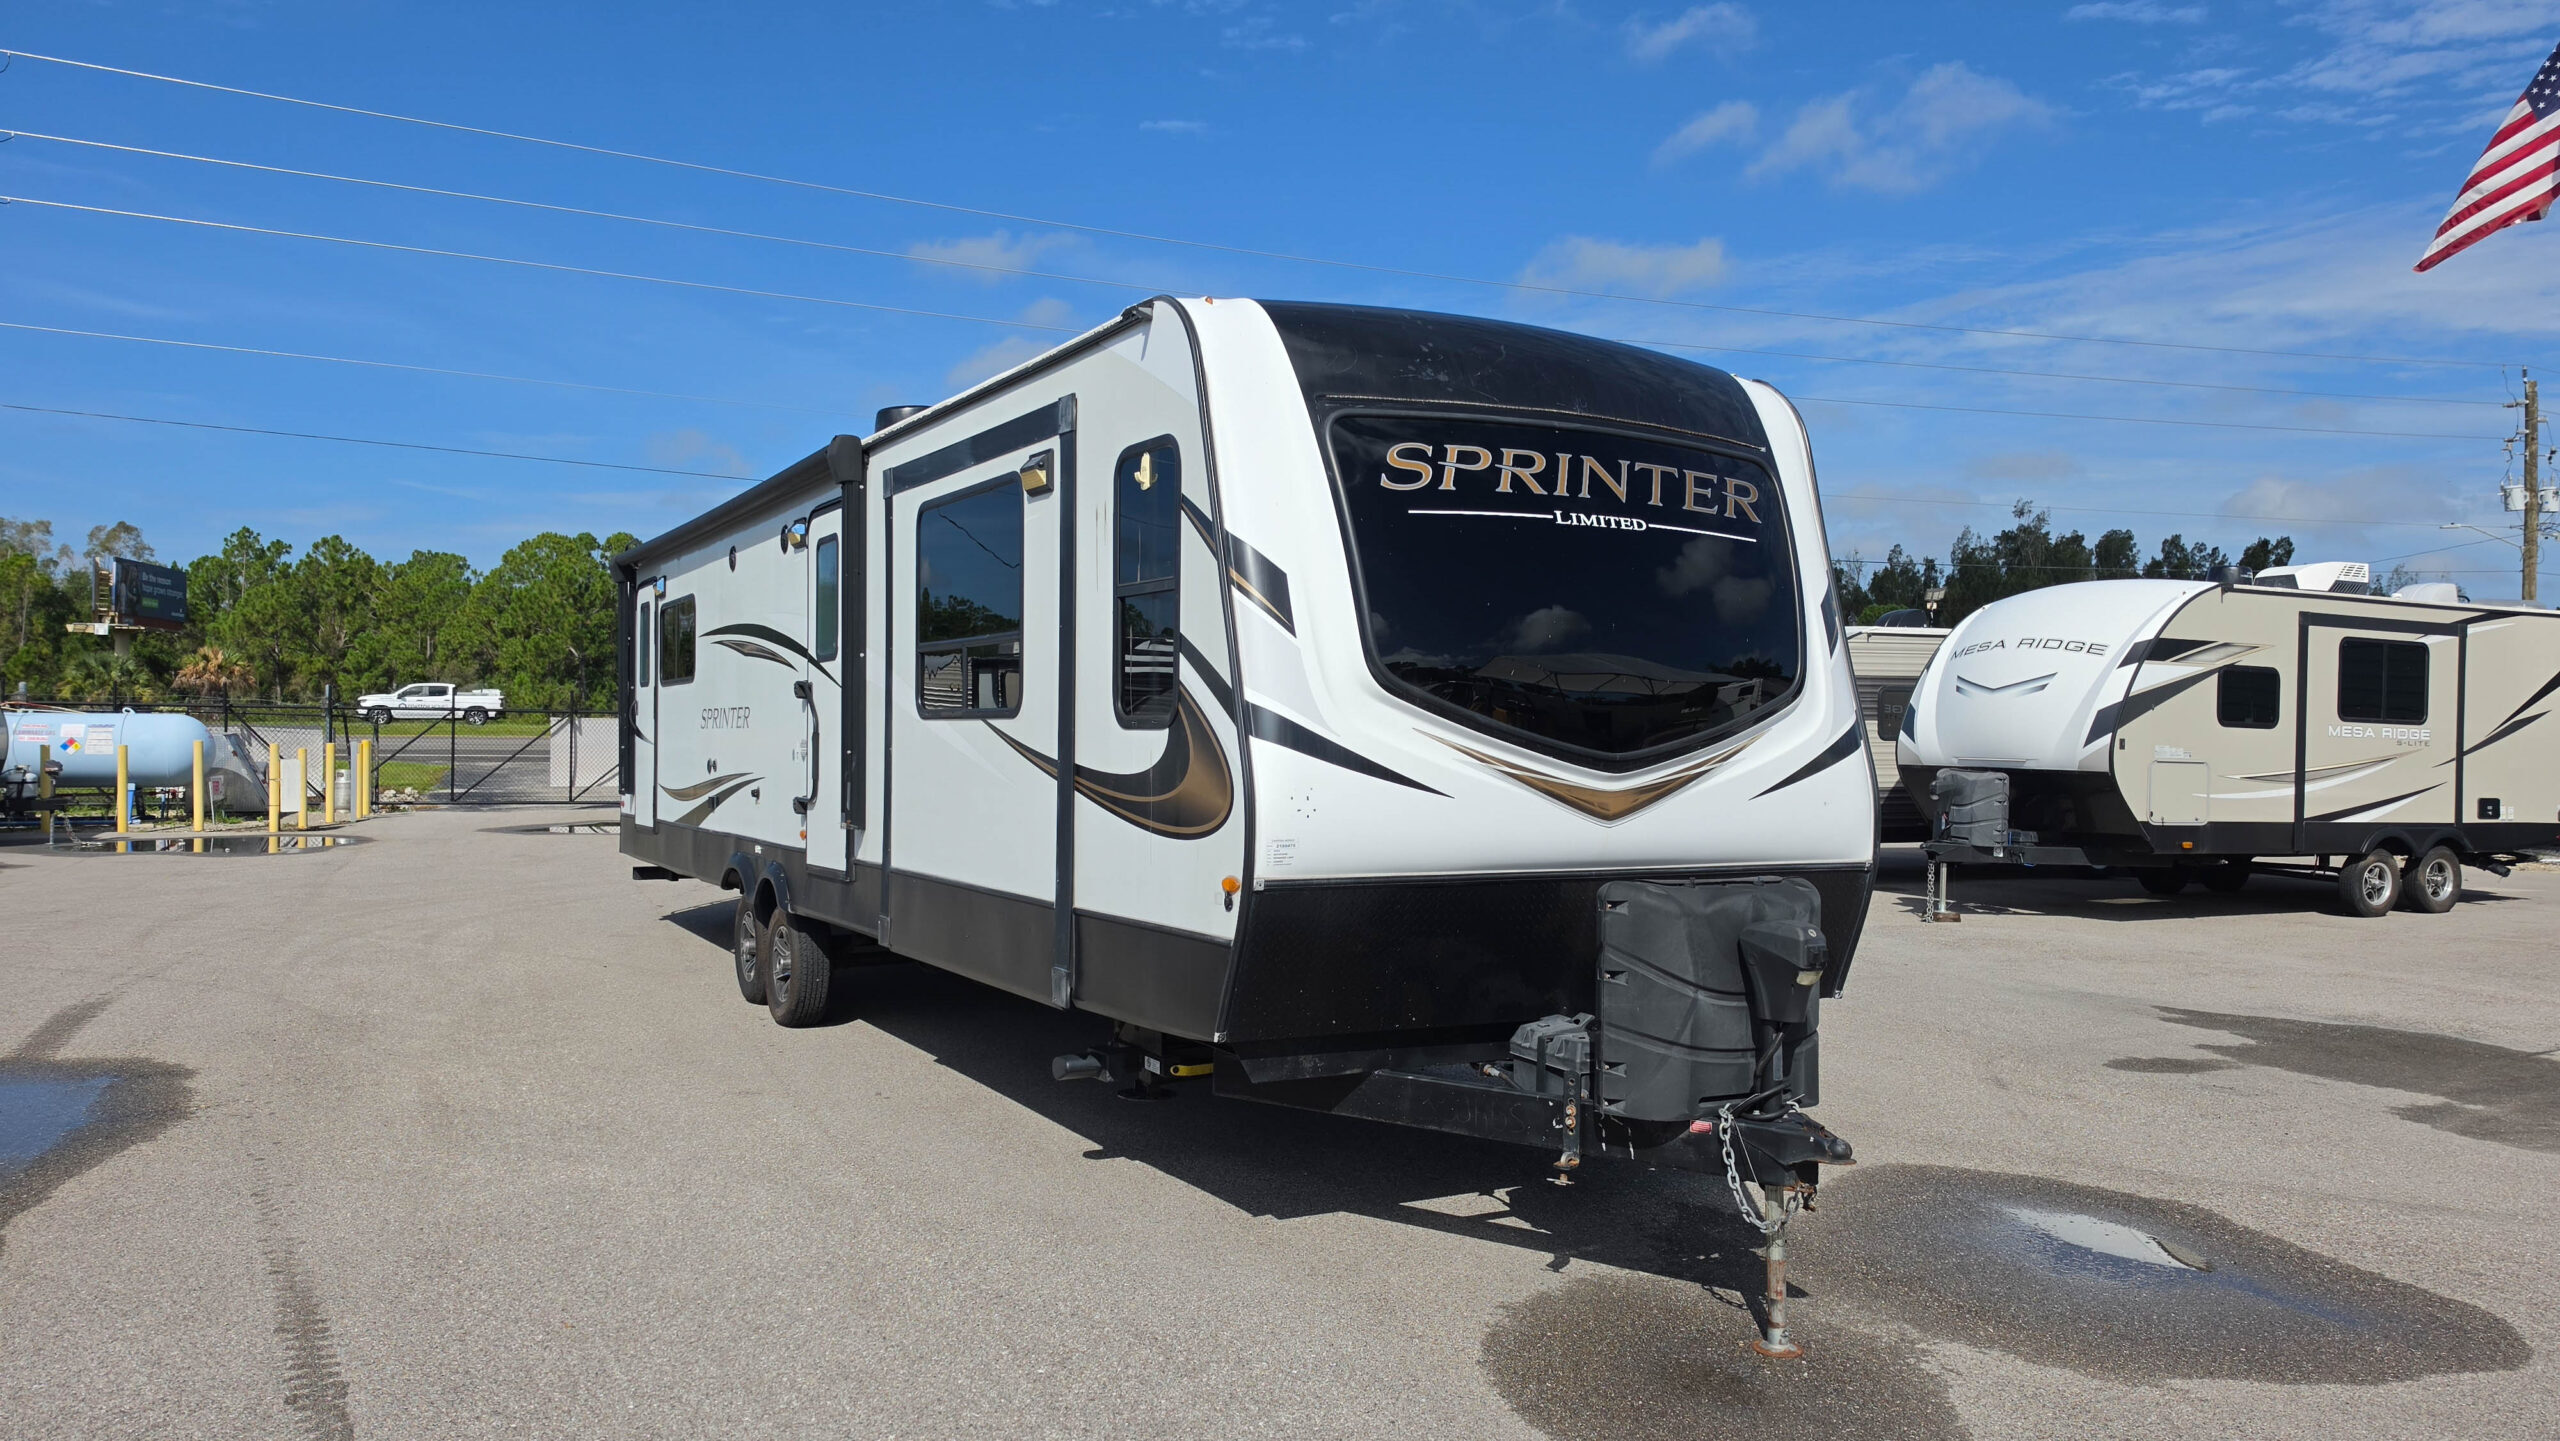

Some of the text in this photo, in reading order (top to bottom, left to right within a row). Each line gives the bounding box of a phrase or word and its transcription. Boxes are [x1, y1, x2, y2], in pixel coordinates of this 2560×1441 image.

[1380, 442, 1762, 523] SPRINTER
[1553, 510, 1647, 531] LIMITED
[1950, 638, 2109, 661] MESA RIDGE
[700, 706, 751, 729] SPRINTER
[2328, 725, 2431, 740] MESA RIDGE
